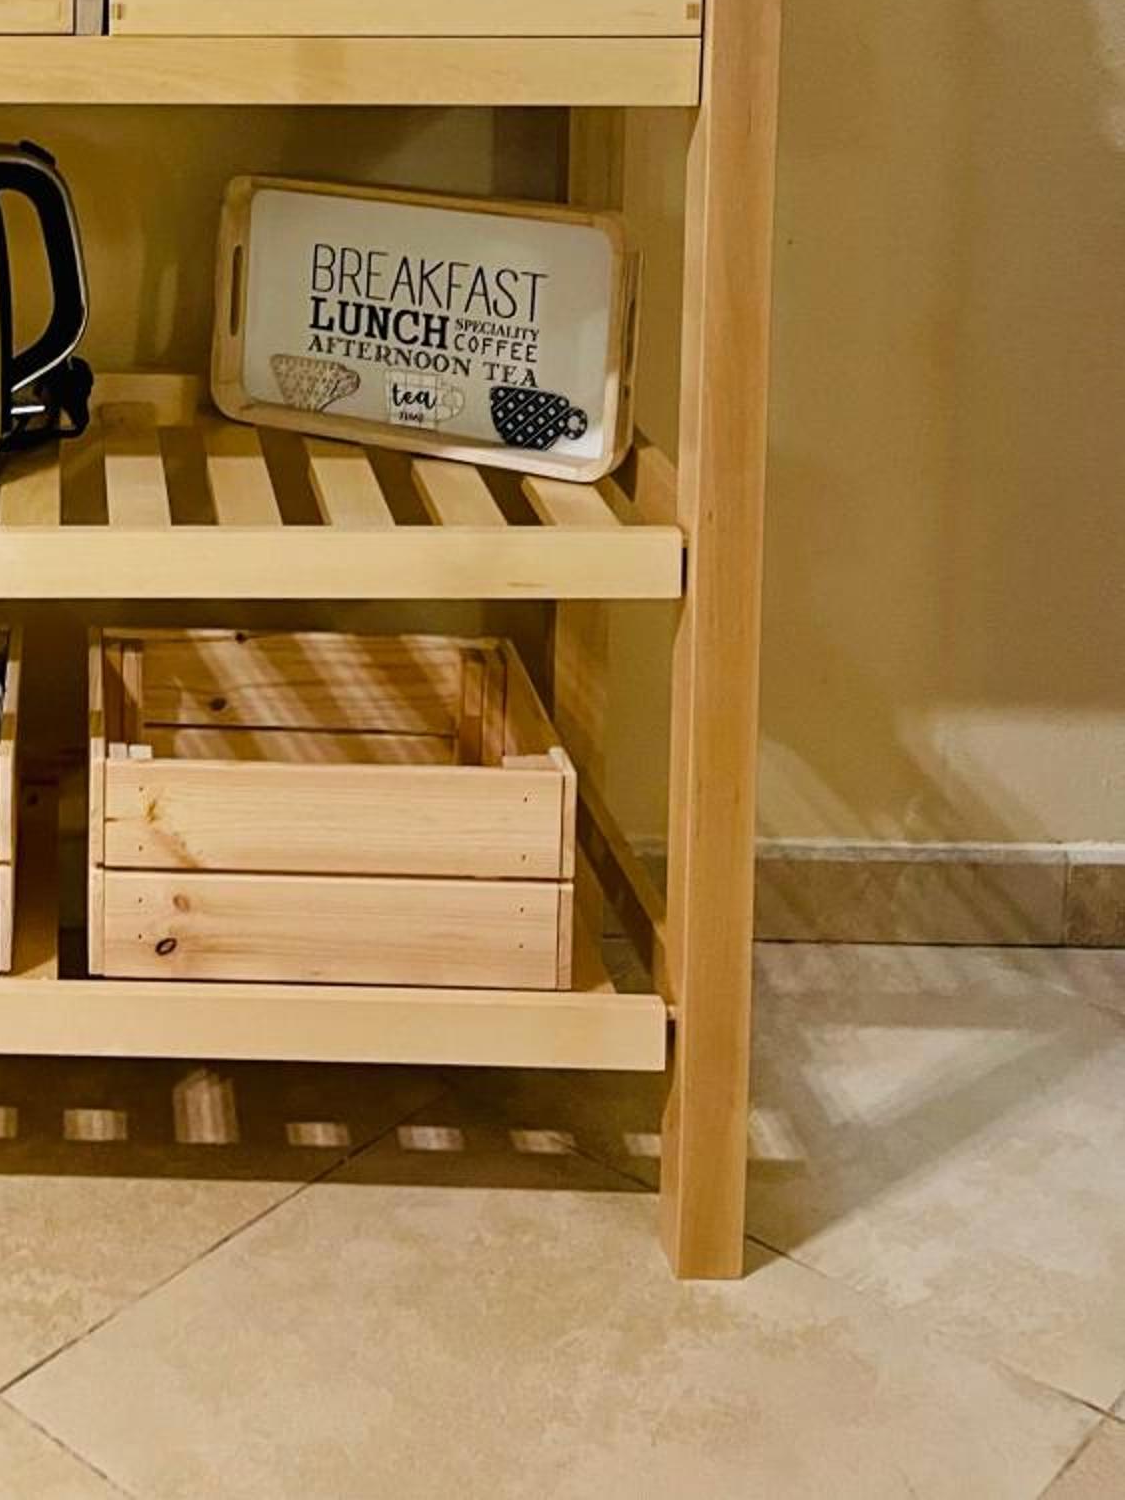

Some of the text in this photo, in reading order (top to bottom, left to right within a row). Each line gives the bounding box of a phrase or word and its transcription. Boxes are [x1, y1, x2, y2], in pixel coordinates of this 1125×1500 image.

[310, 243, 550, 323] BREAKFAST
[308, 296, 450, 350] LUNCH
[455, 318, 540, 342] SPECIALITY
[307, 334, 539, 388] AFTERNOON TEA
[453, 333, 538, 363] COFFEE
[392, 382, 438, 410] tea
